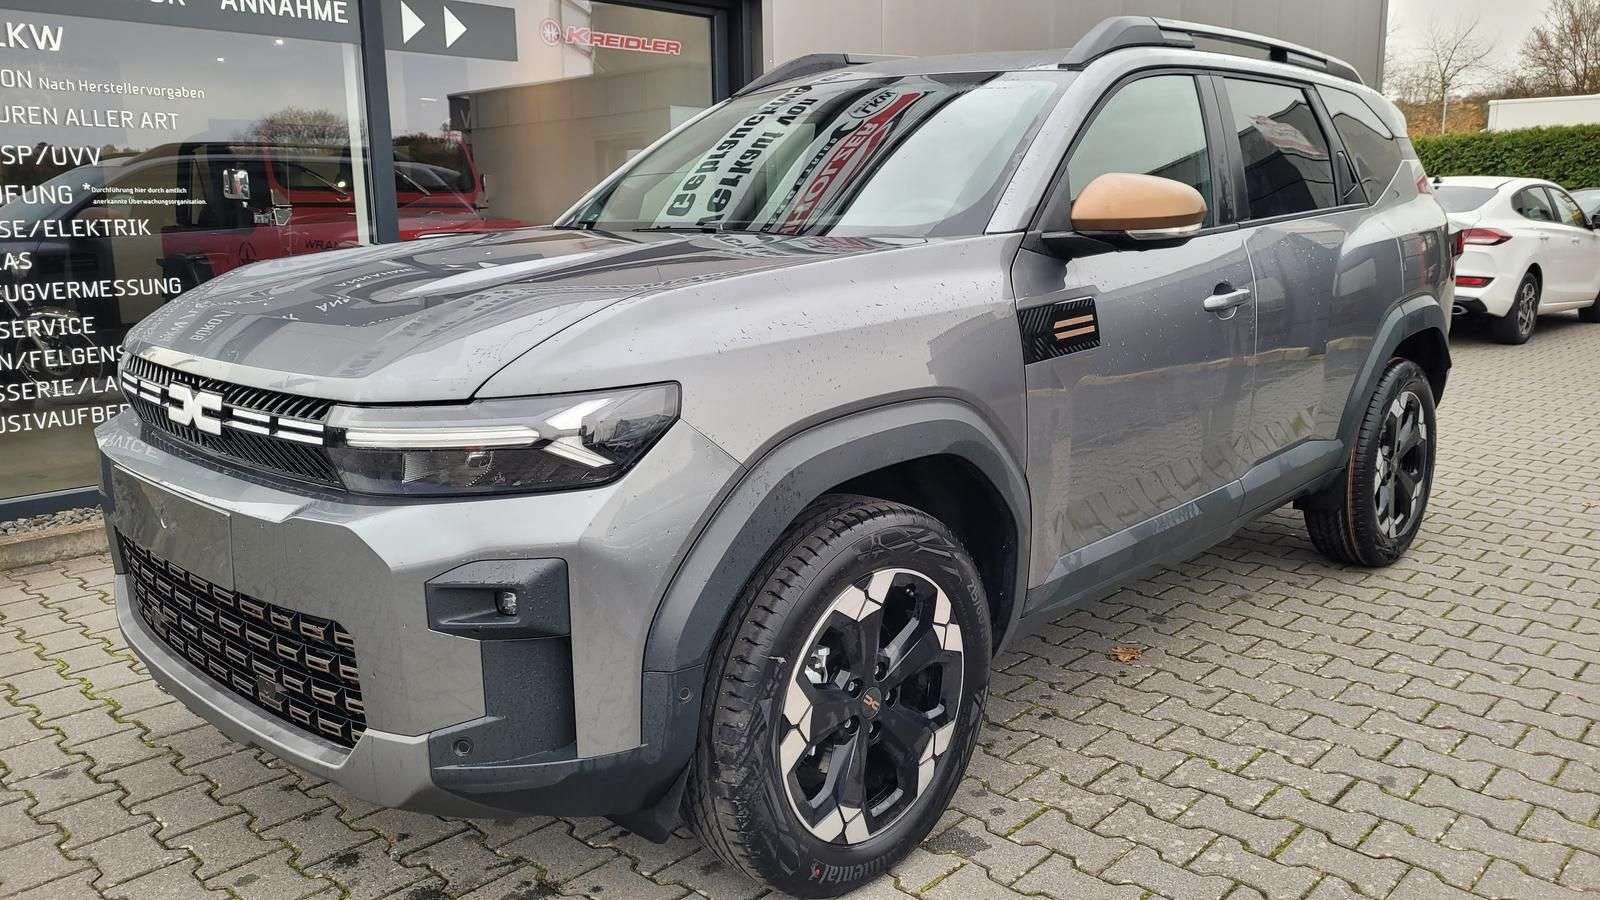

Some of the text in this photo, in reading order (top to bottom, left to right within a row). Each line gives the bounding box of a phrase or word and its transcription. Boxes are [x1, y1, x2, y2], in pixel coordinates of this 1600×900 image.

[0, 22, 63, 51] KW
[565, 25, 682, 55] KREIDLER
[39, 77, 75, 91] Nach
[78, 79, 205, 100] Herstellervorgaben
[65, 108, 135, 128] ALLER
[141, 111, 179, 130] ART
[0, 144, 101, 166] SP/UVV
[0, 184, 73, 205] FUNG
[0, 218, 151, 238] SE/ELEKTRIK
[0, 252, 32, 271] AS
[0, 277, 182, 303] UGVERMESSUNG
[0, 316, 96, 340] SERVICE
